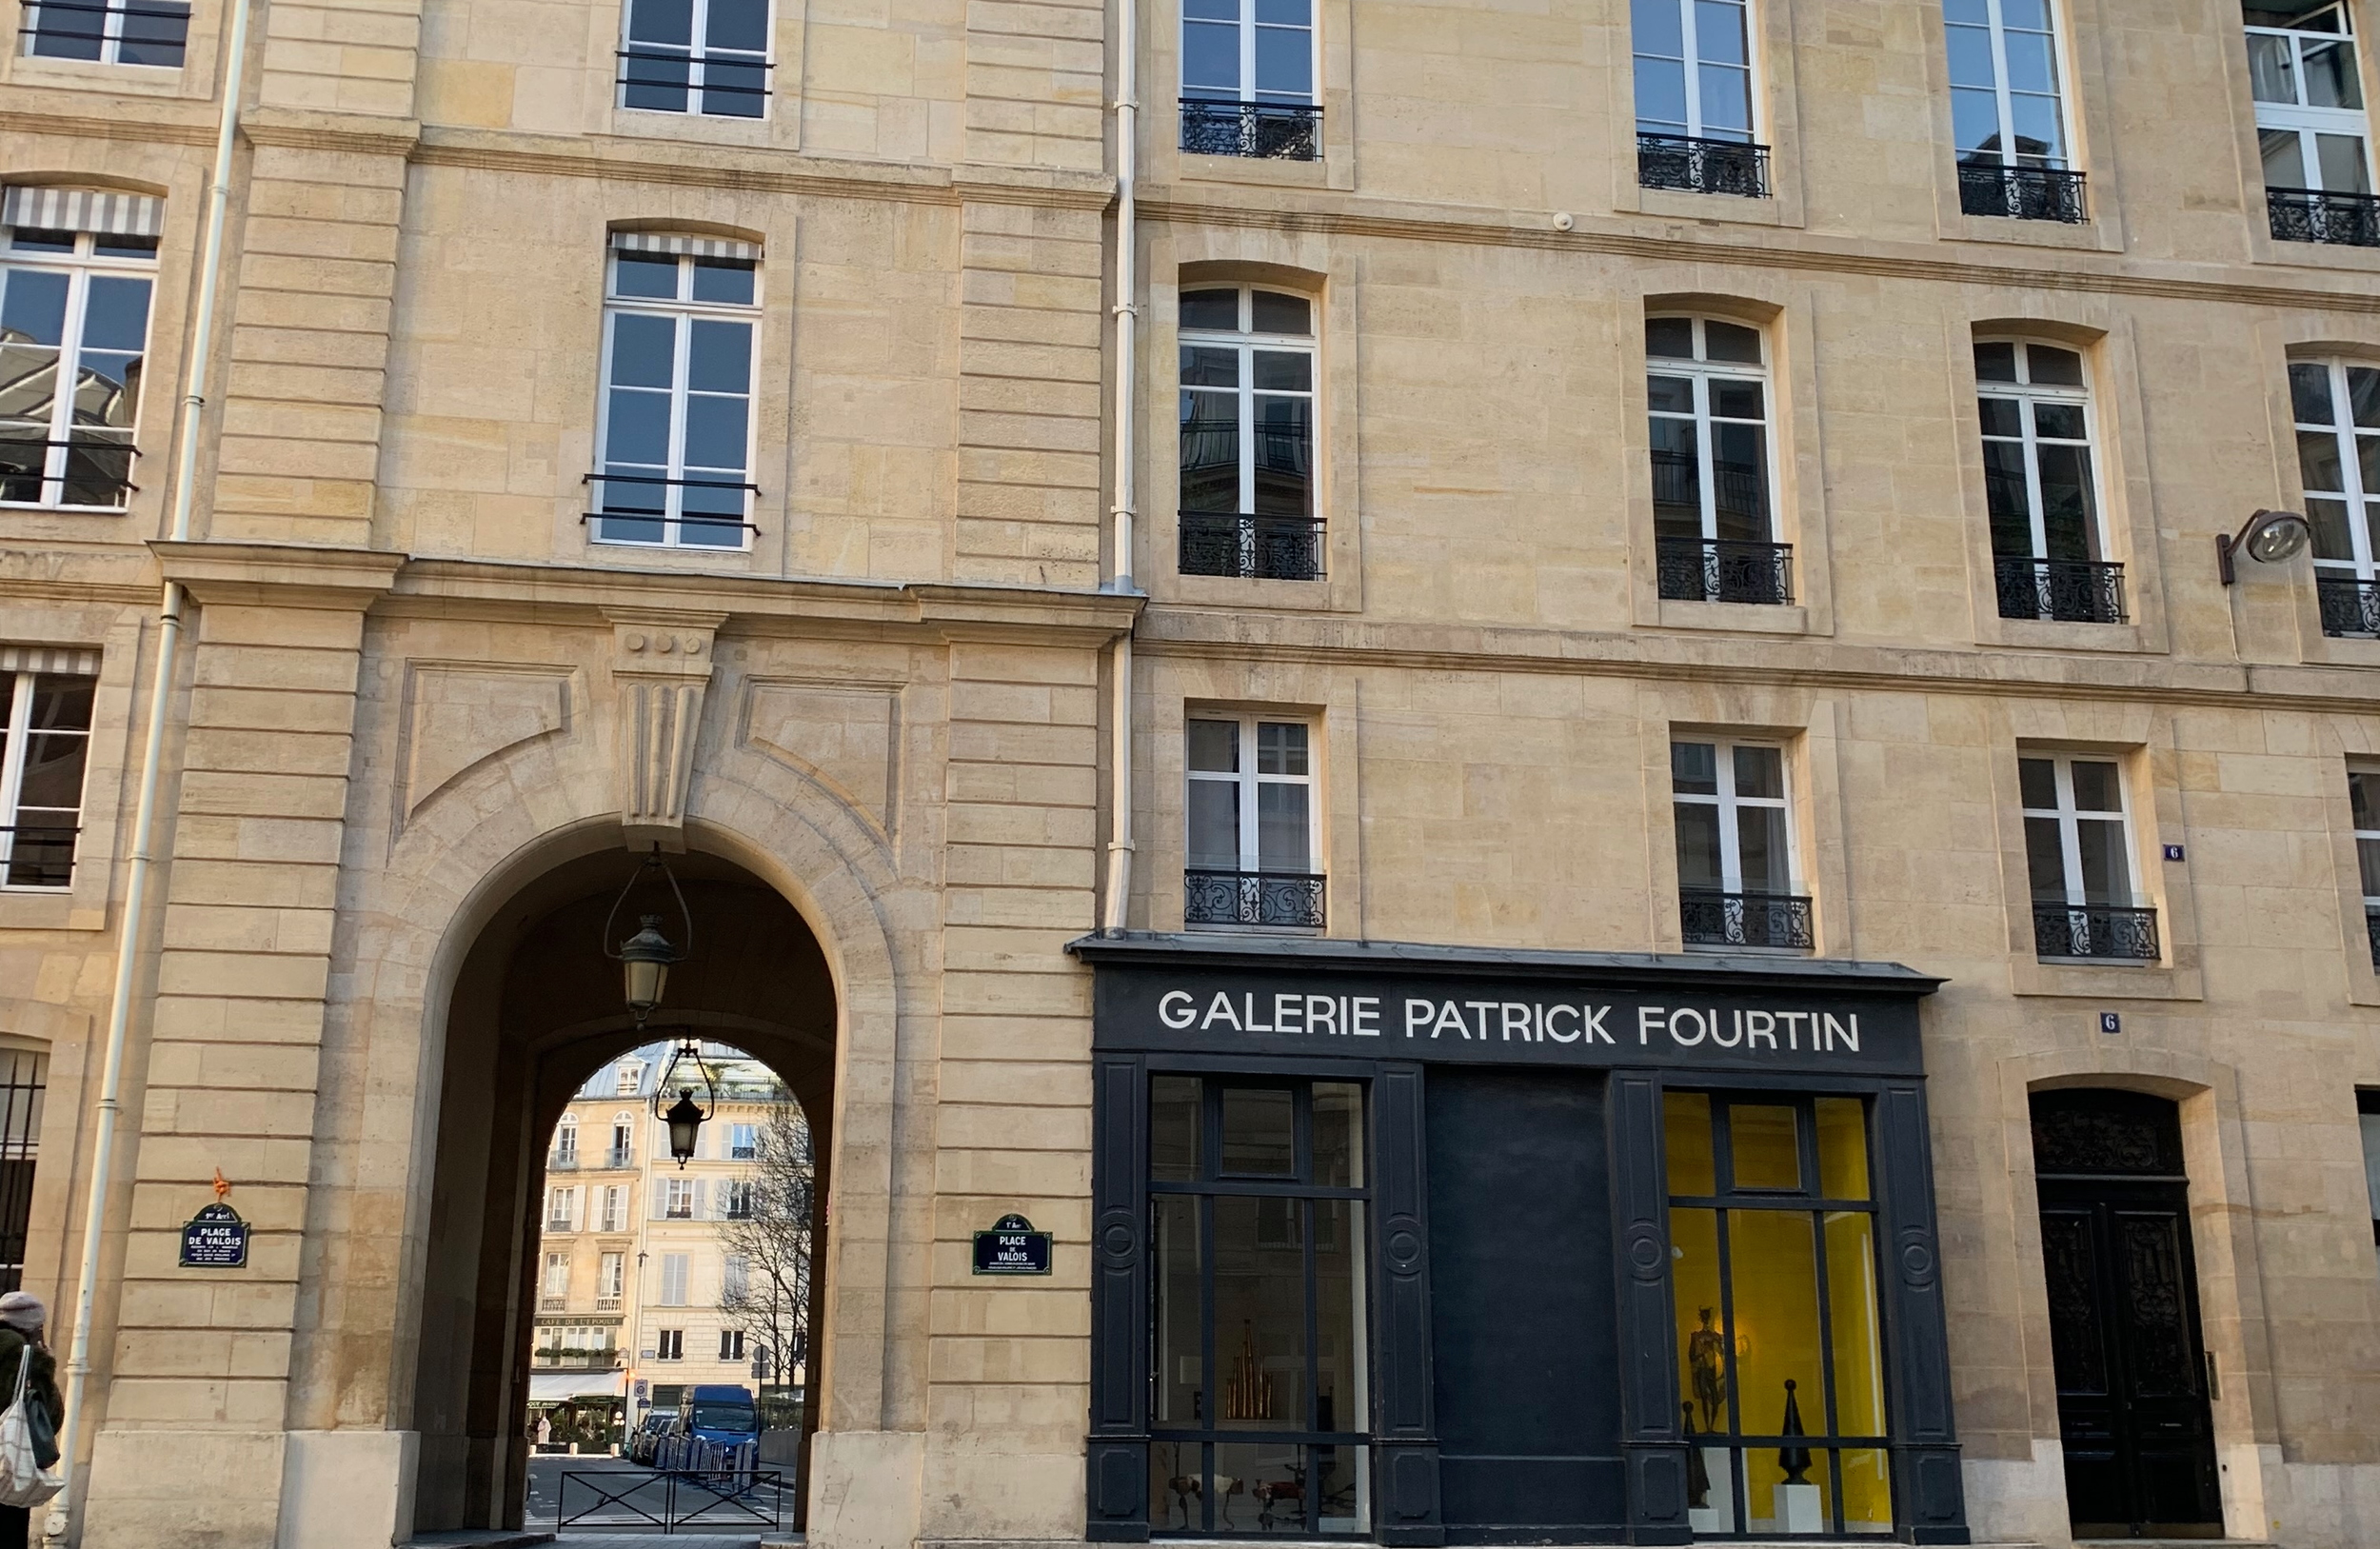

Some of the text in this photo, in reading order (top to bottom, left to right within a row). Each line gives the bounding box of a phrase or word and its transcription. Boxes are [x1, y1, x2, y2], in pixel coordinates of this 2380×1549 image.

[2170, 846, 2179, 859] 6
[1159, 990, 1860, 1052] GALERIE PATRICK FOURTIN
[2105, 1015, 2115, 1030] 6
[207, 1237, 242, 1245] VALOIS
[1000, 1236, 1026, 1245] PLACE
[998, 1252, 1028, 1261] VALOIS
